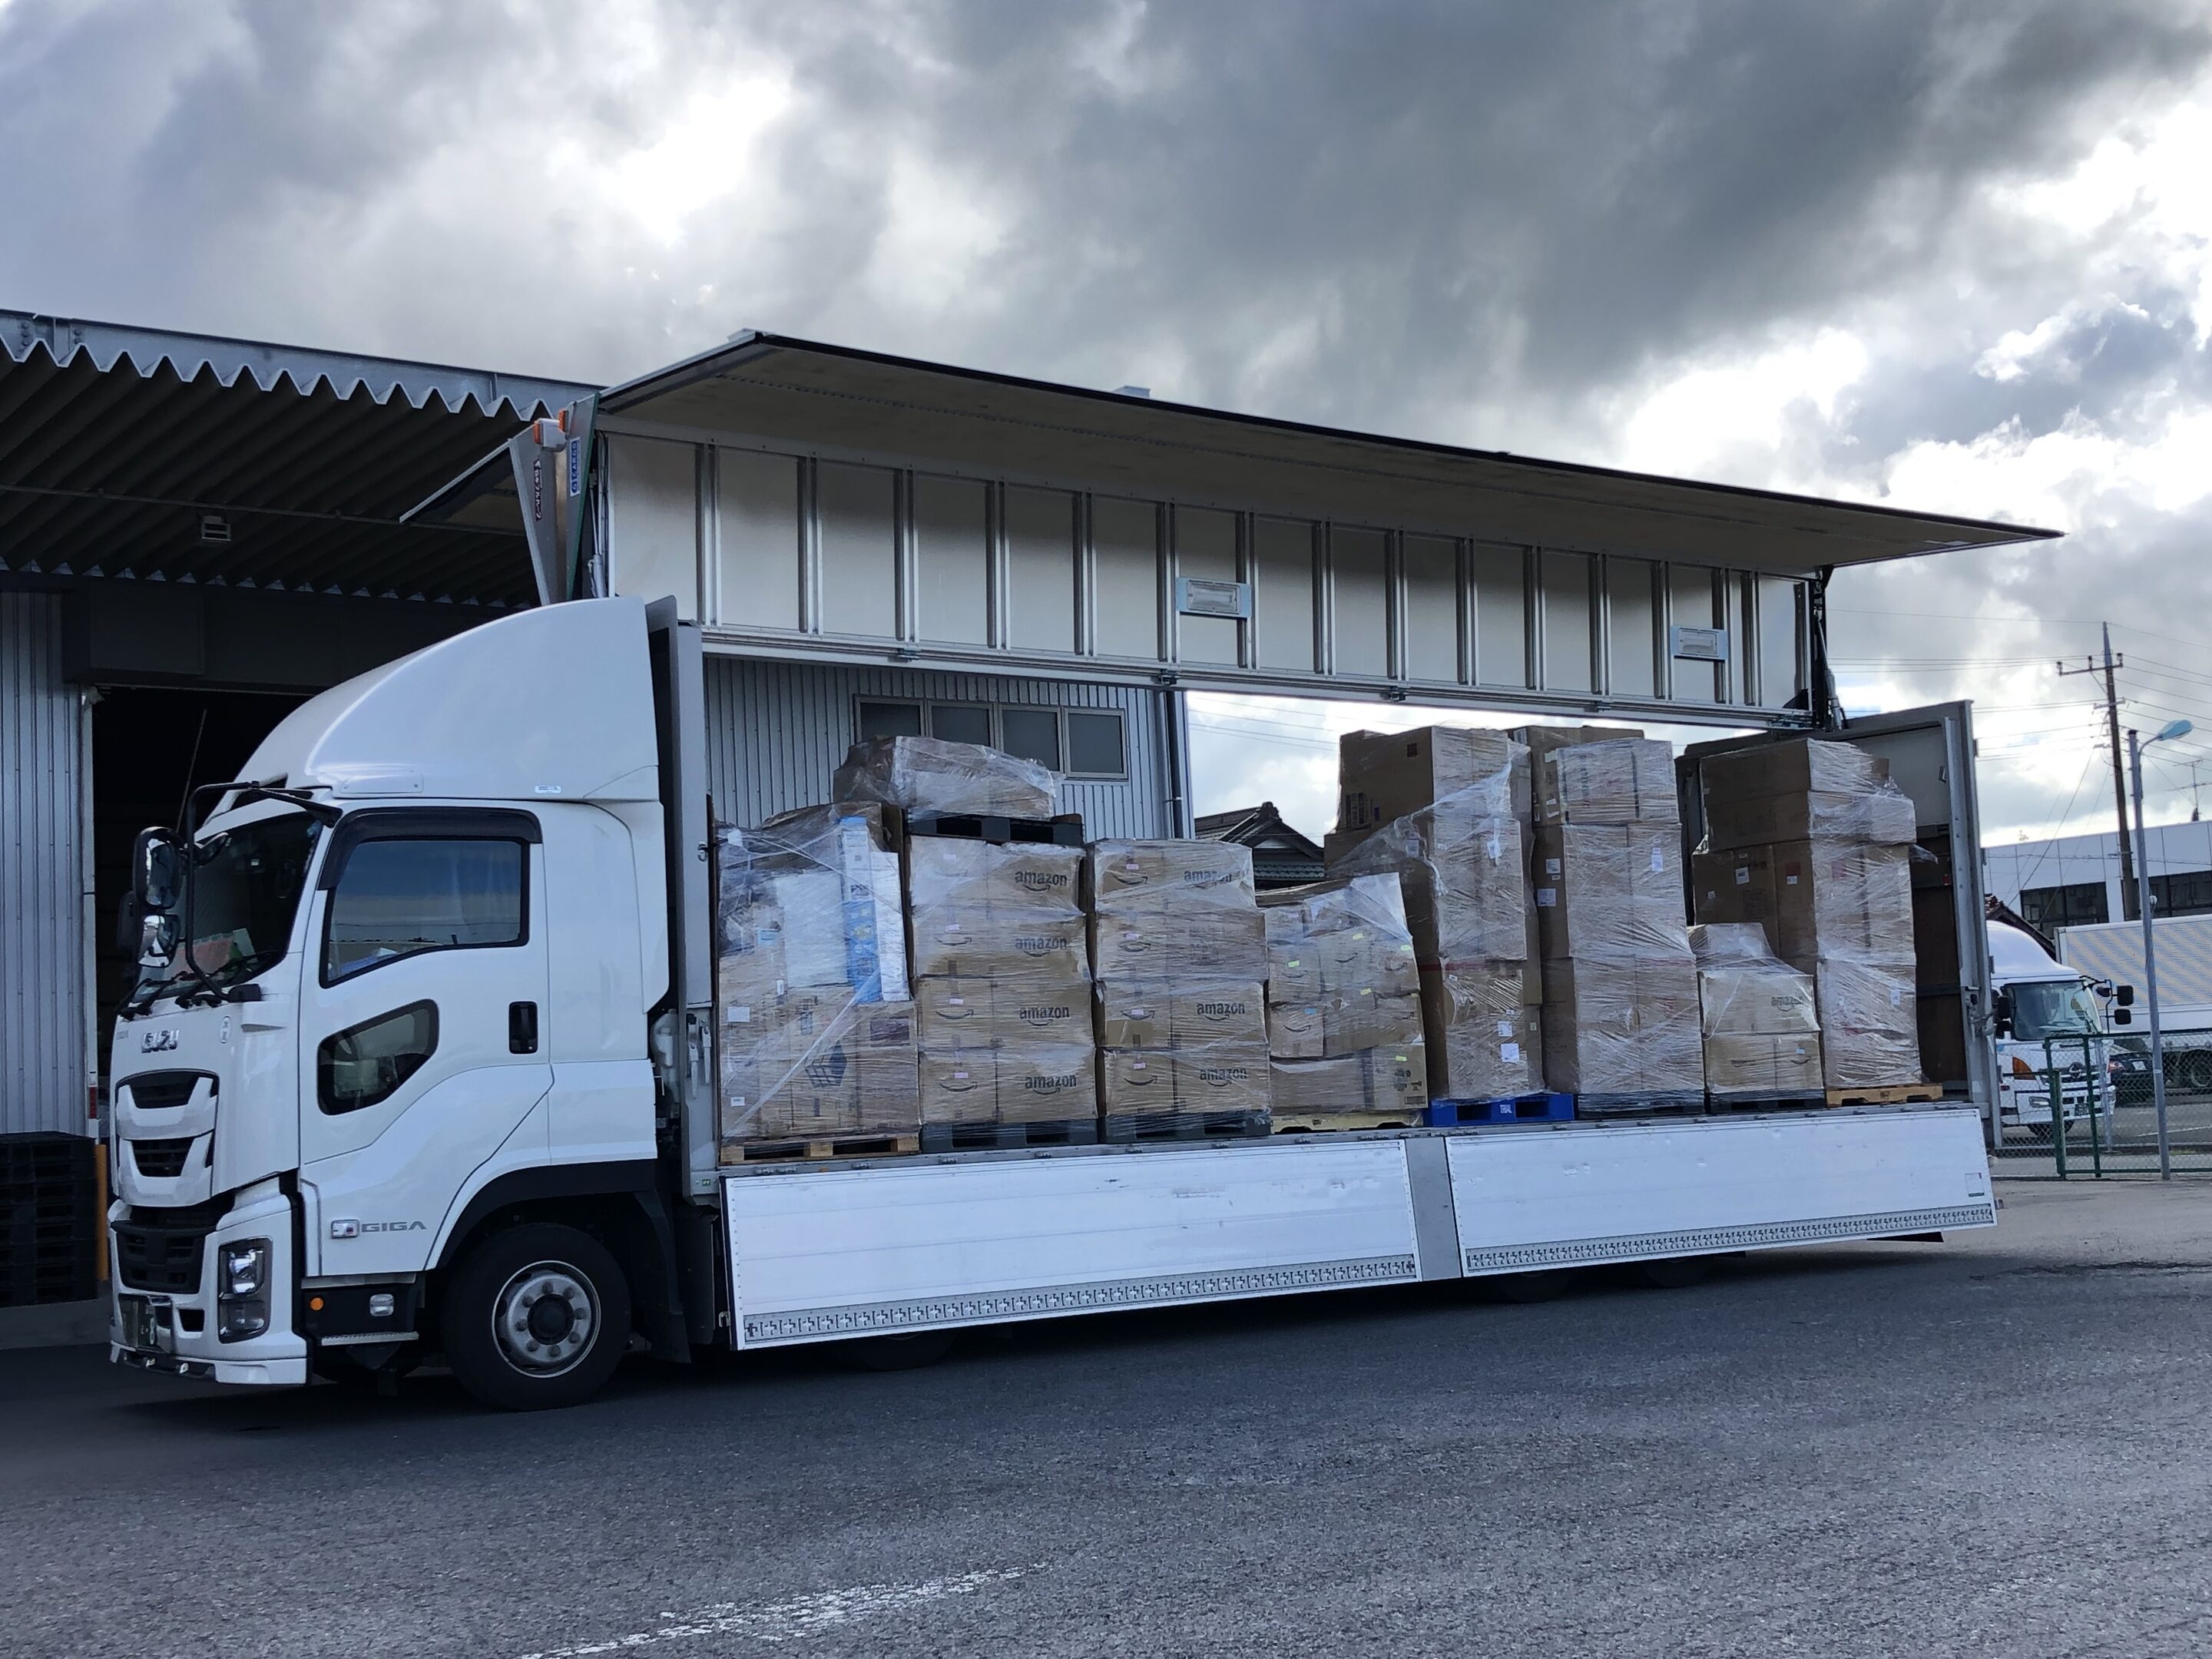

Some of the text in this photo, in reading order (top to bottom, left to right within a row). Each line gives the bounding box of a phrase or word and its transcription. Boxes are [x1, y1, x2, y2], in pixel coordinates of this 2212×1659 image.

[1015, 870, 1068, 886] amazon
[1015, 937, 1068, 950] amazon
[1019, 1006, 1070, 1019] amazon
[1197, 1002, 1246, 1015] amazon
[141, 1028, 180, 1053] ISUZU
[1200, 1068, 1248, 1081] amazon
[1025, 1075, 1077, 1089] amazon
[361, 1220, 427, 1233] GIGA
